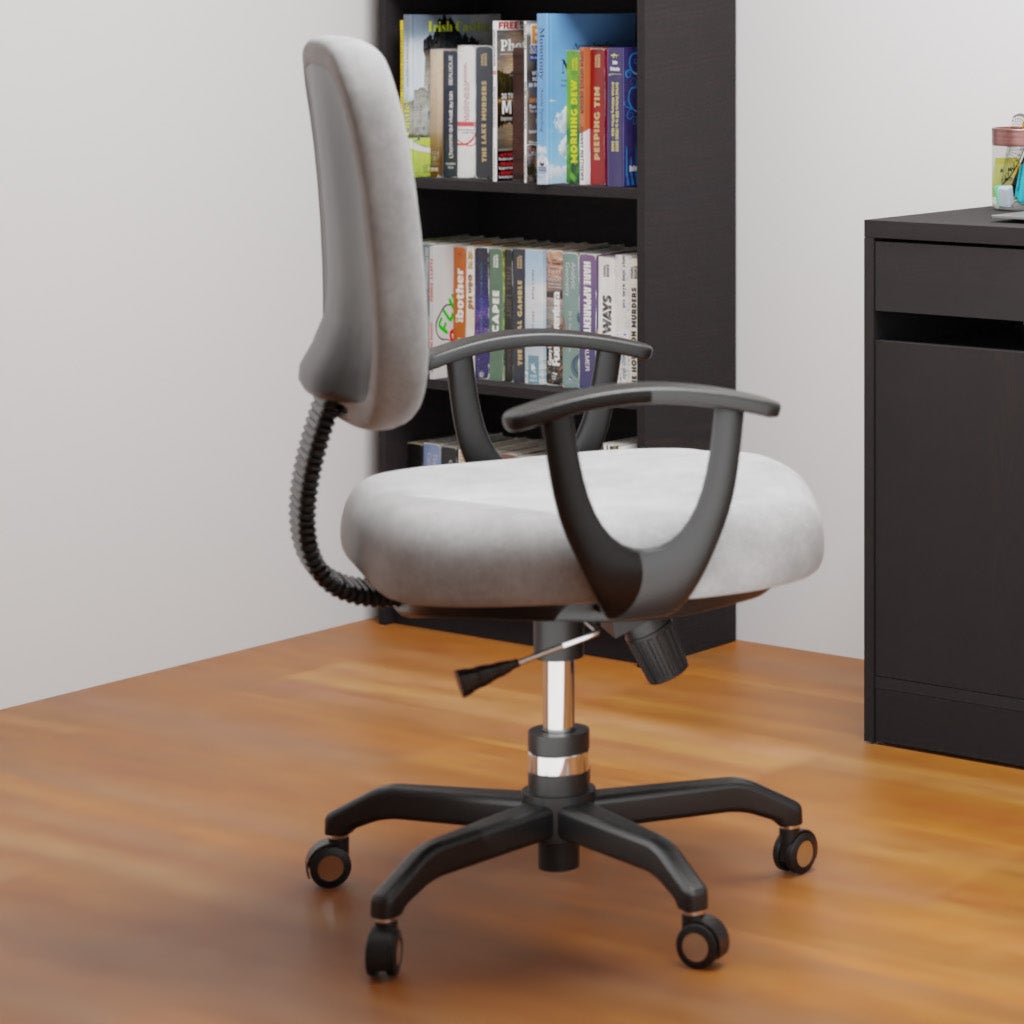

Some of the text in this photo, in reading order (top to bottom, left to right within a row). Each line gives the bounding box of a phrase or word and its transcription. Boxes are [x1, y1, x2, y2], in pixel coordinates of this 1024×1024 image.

[428, 20, 452, 32] Irish
[498, 22, 518, 30] FREE
[570, 80, 578, 164] MORNING DEW
[583, 261, 592, 285] HARE
[492, 289, 500, 332] CAPEE
[583, 286, 592, 333] APPARENT
